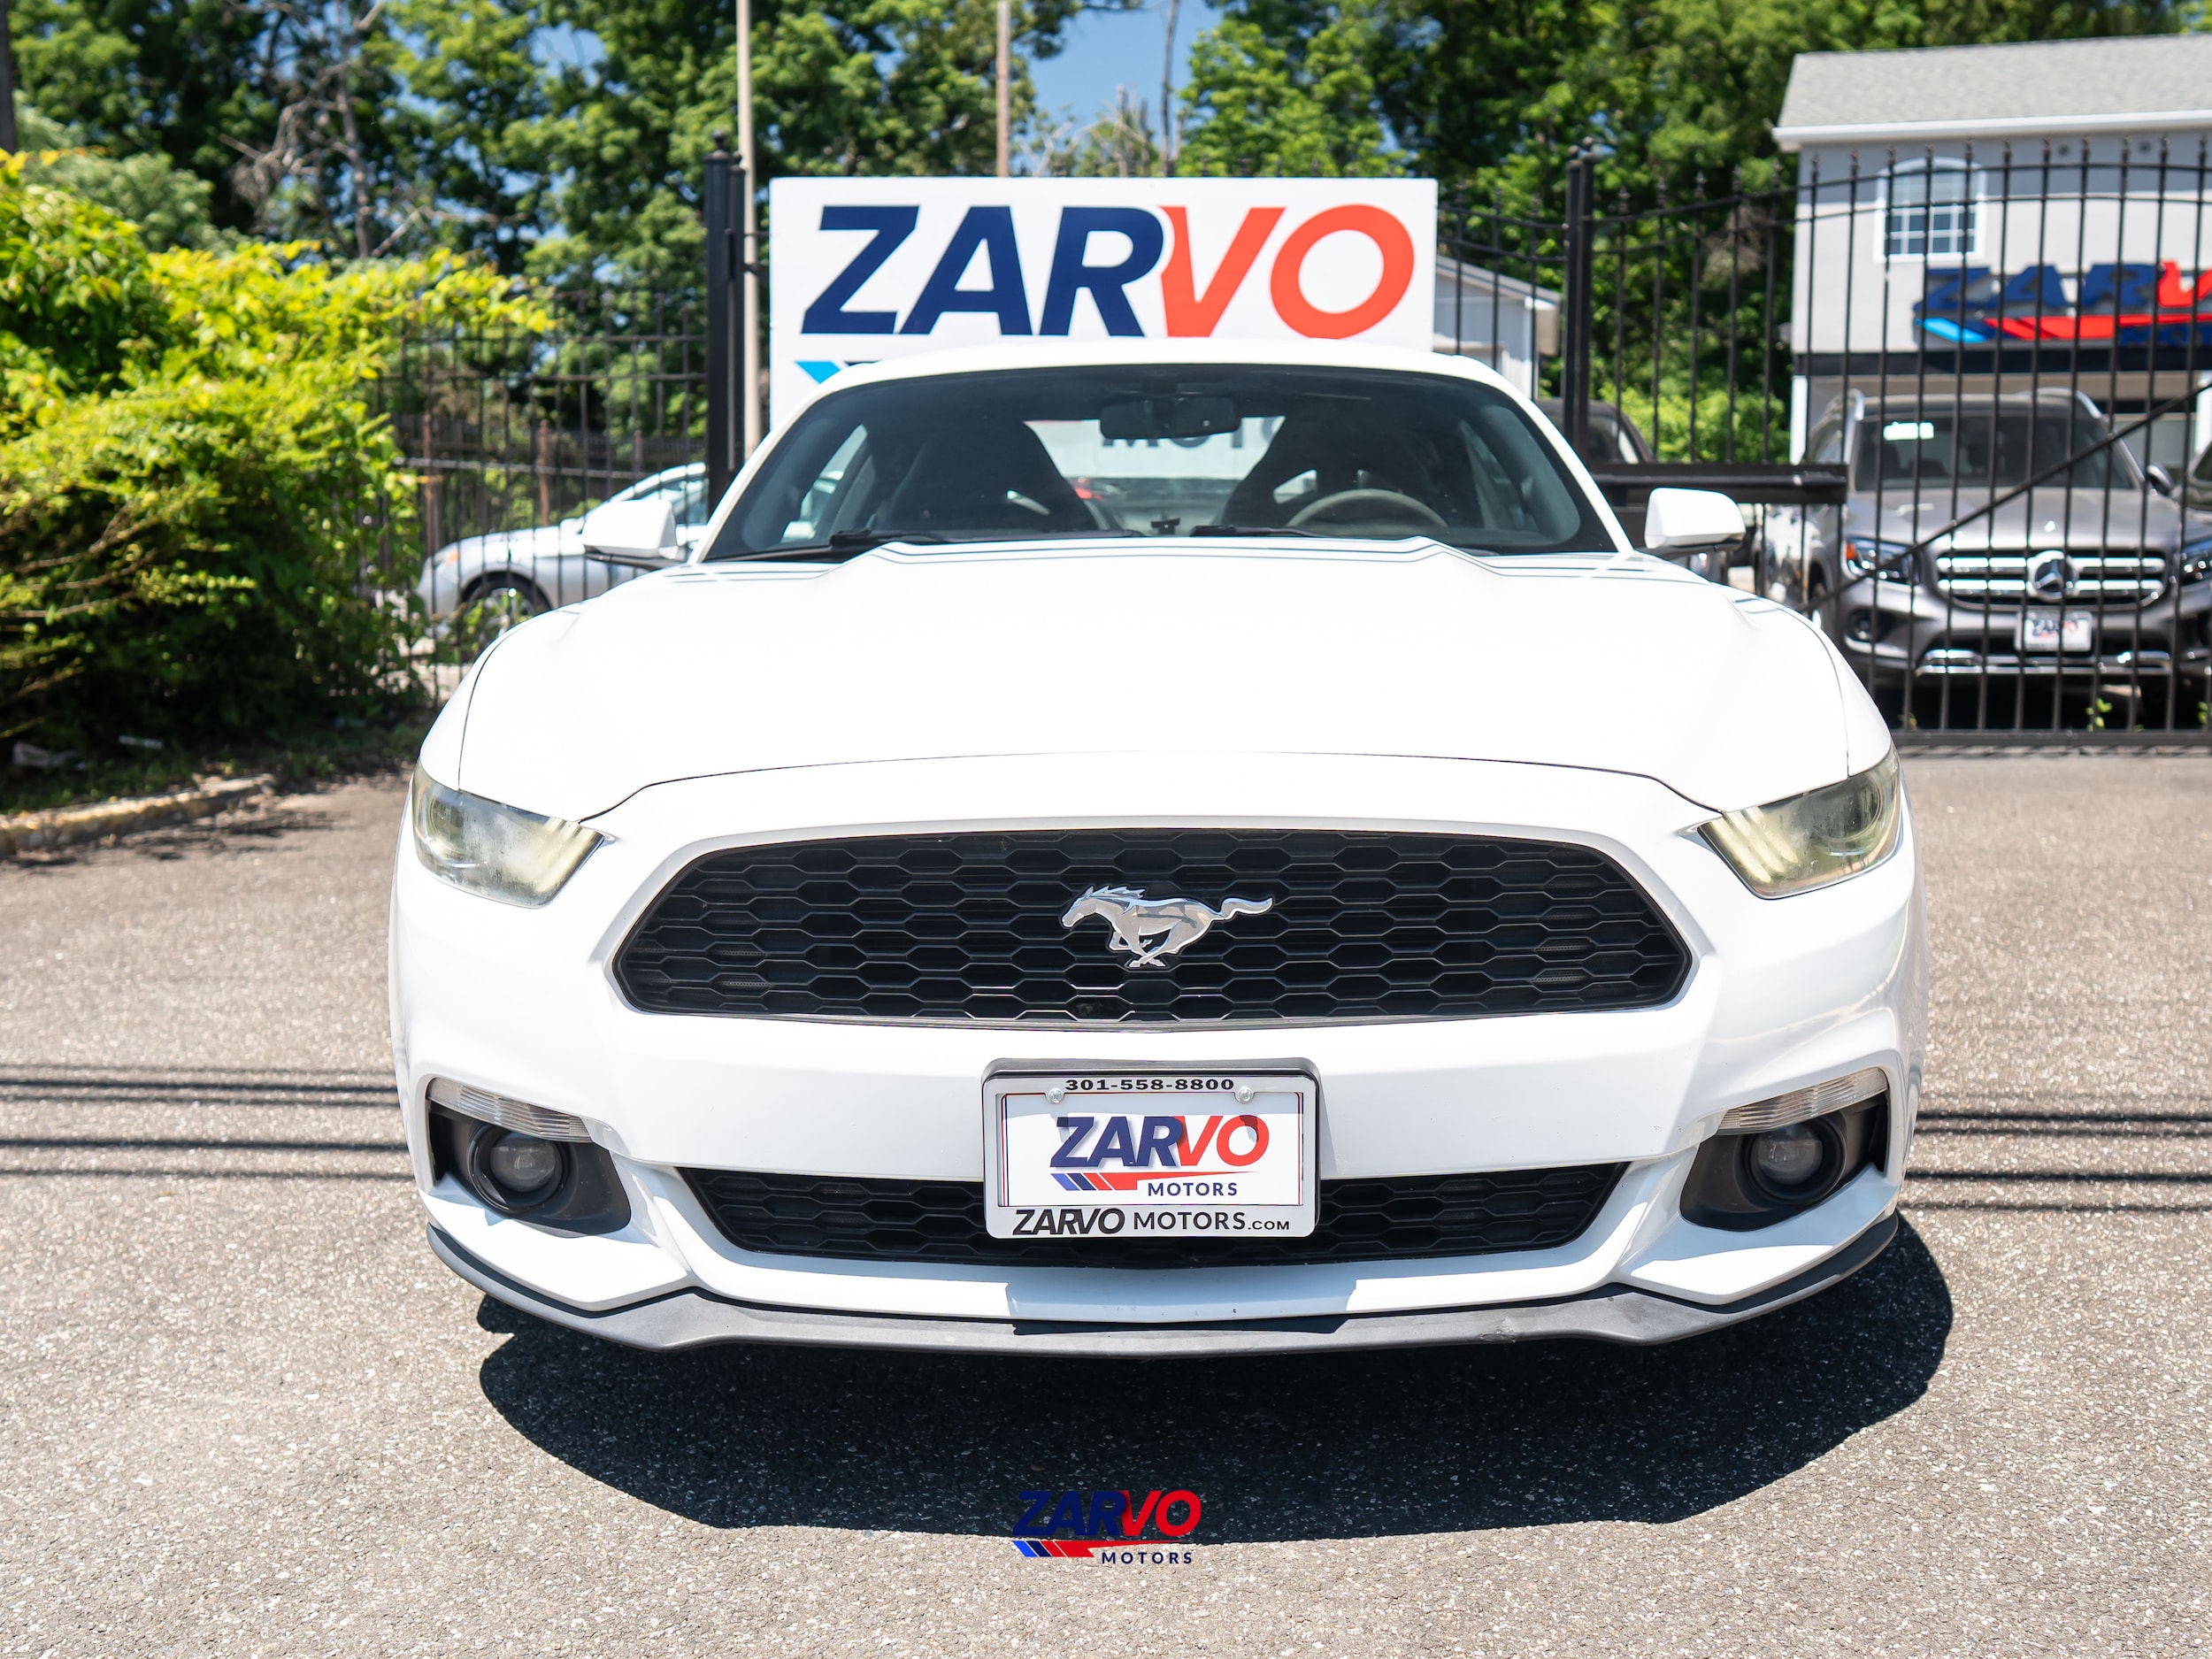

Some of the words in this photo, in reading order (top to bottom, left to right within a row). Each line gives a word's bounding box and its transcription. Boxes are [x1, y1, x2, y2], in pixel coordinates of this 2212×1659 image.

[800, 204, 1416, 340] ZARVO
[1064, 1079, 1235, 1091] 301-558-8800
[1048, 1114, 1270, 1168] ZARVO
[1148, 1182, 1238, 1196] MOTORS
[1012, 1207, 1125, 1235] ZARVO
